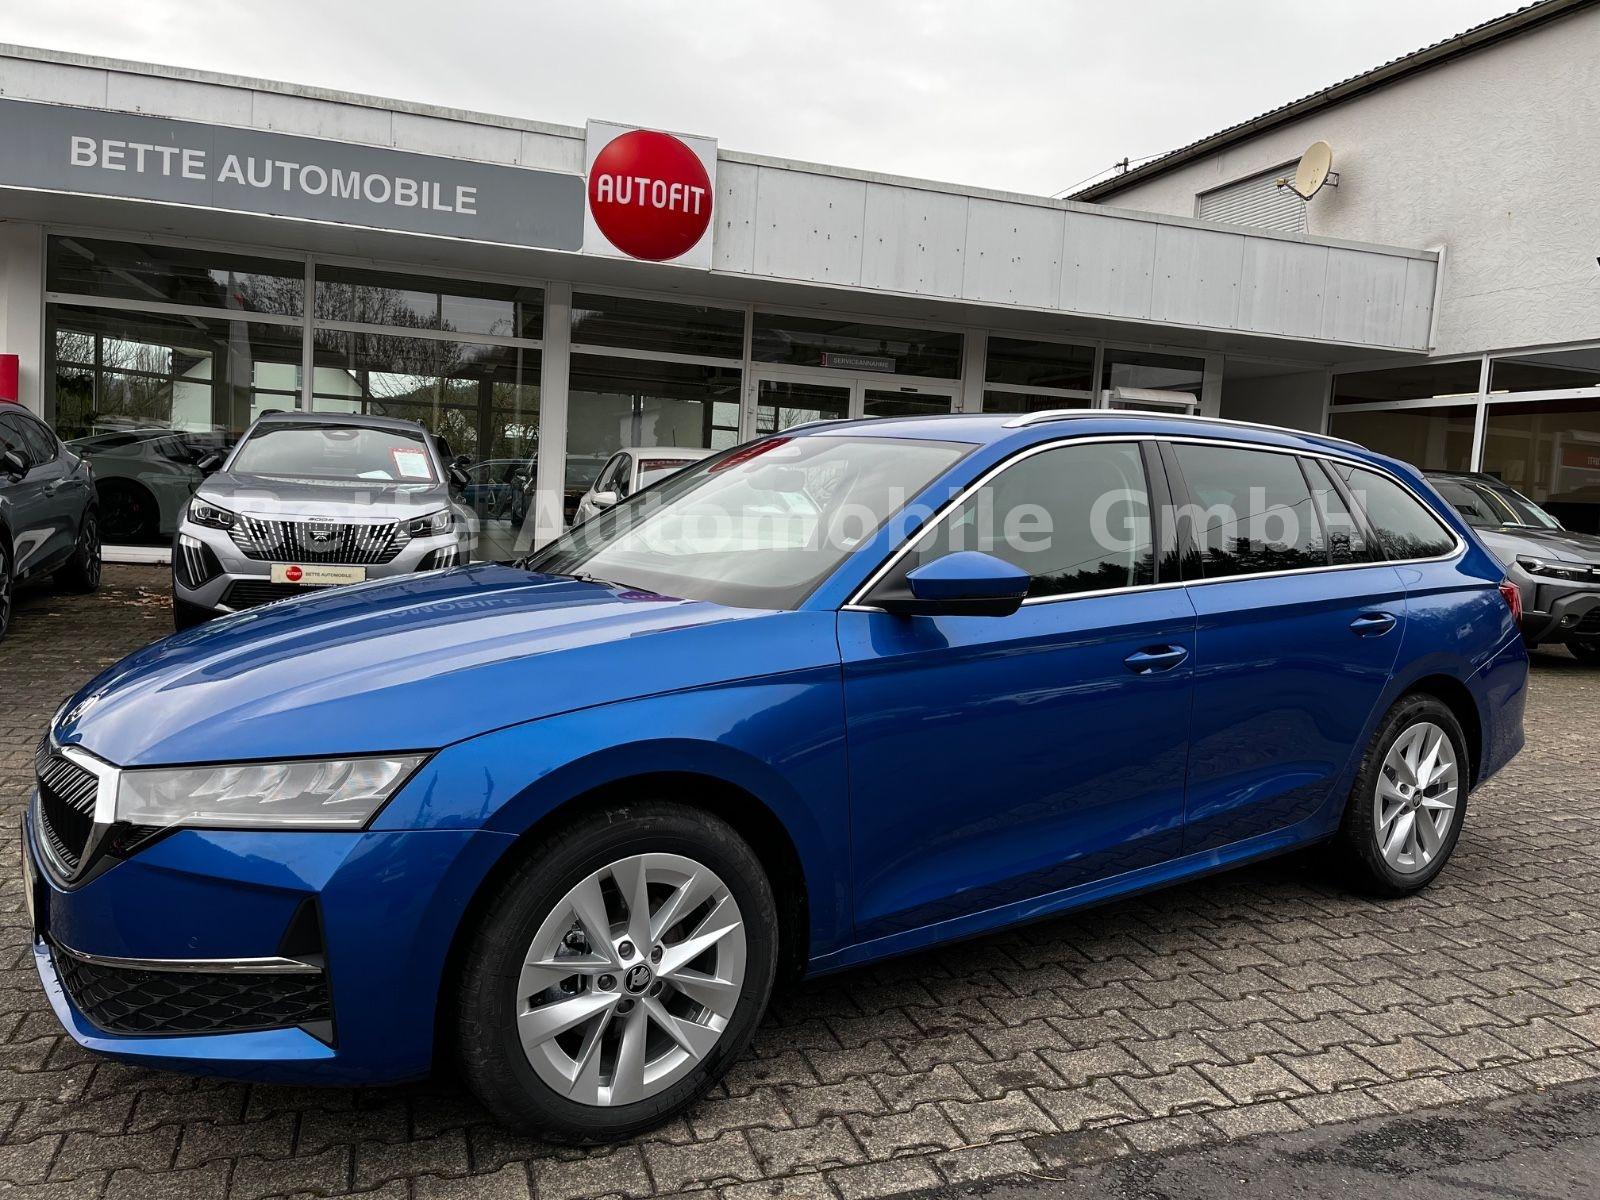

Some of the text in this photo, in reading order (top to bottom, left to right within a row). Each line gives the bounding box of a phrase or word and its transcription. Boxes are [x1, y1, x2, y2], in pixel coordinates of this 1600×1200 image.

[69, 137, 478, 215] BETTE AUTOMOBILE
[597, 174, 705, 215] AUTOFIT
[833, 357, 889, 368] SERVICEANNAHME
